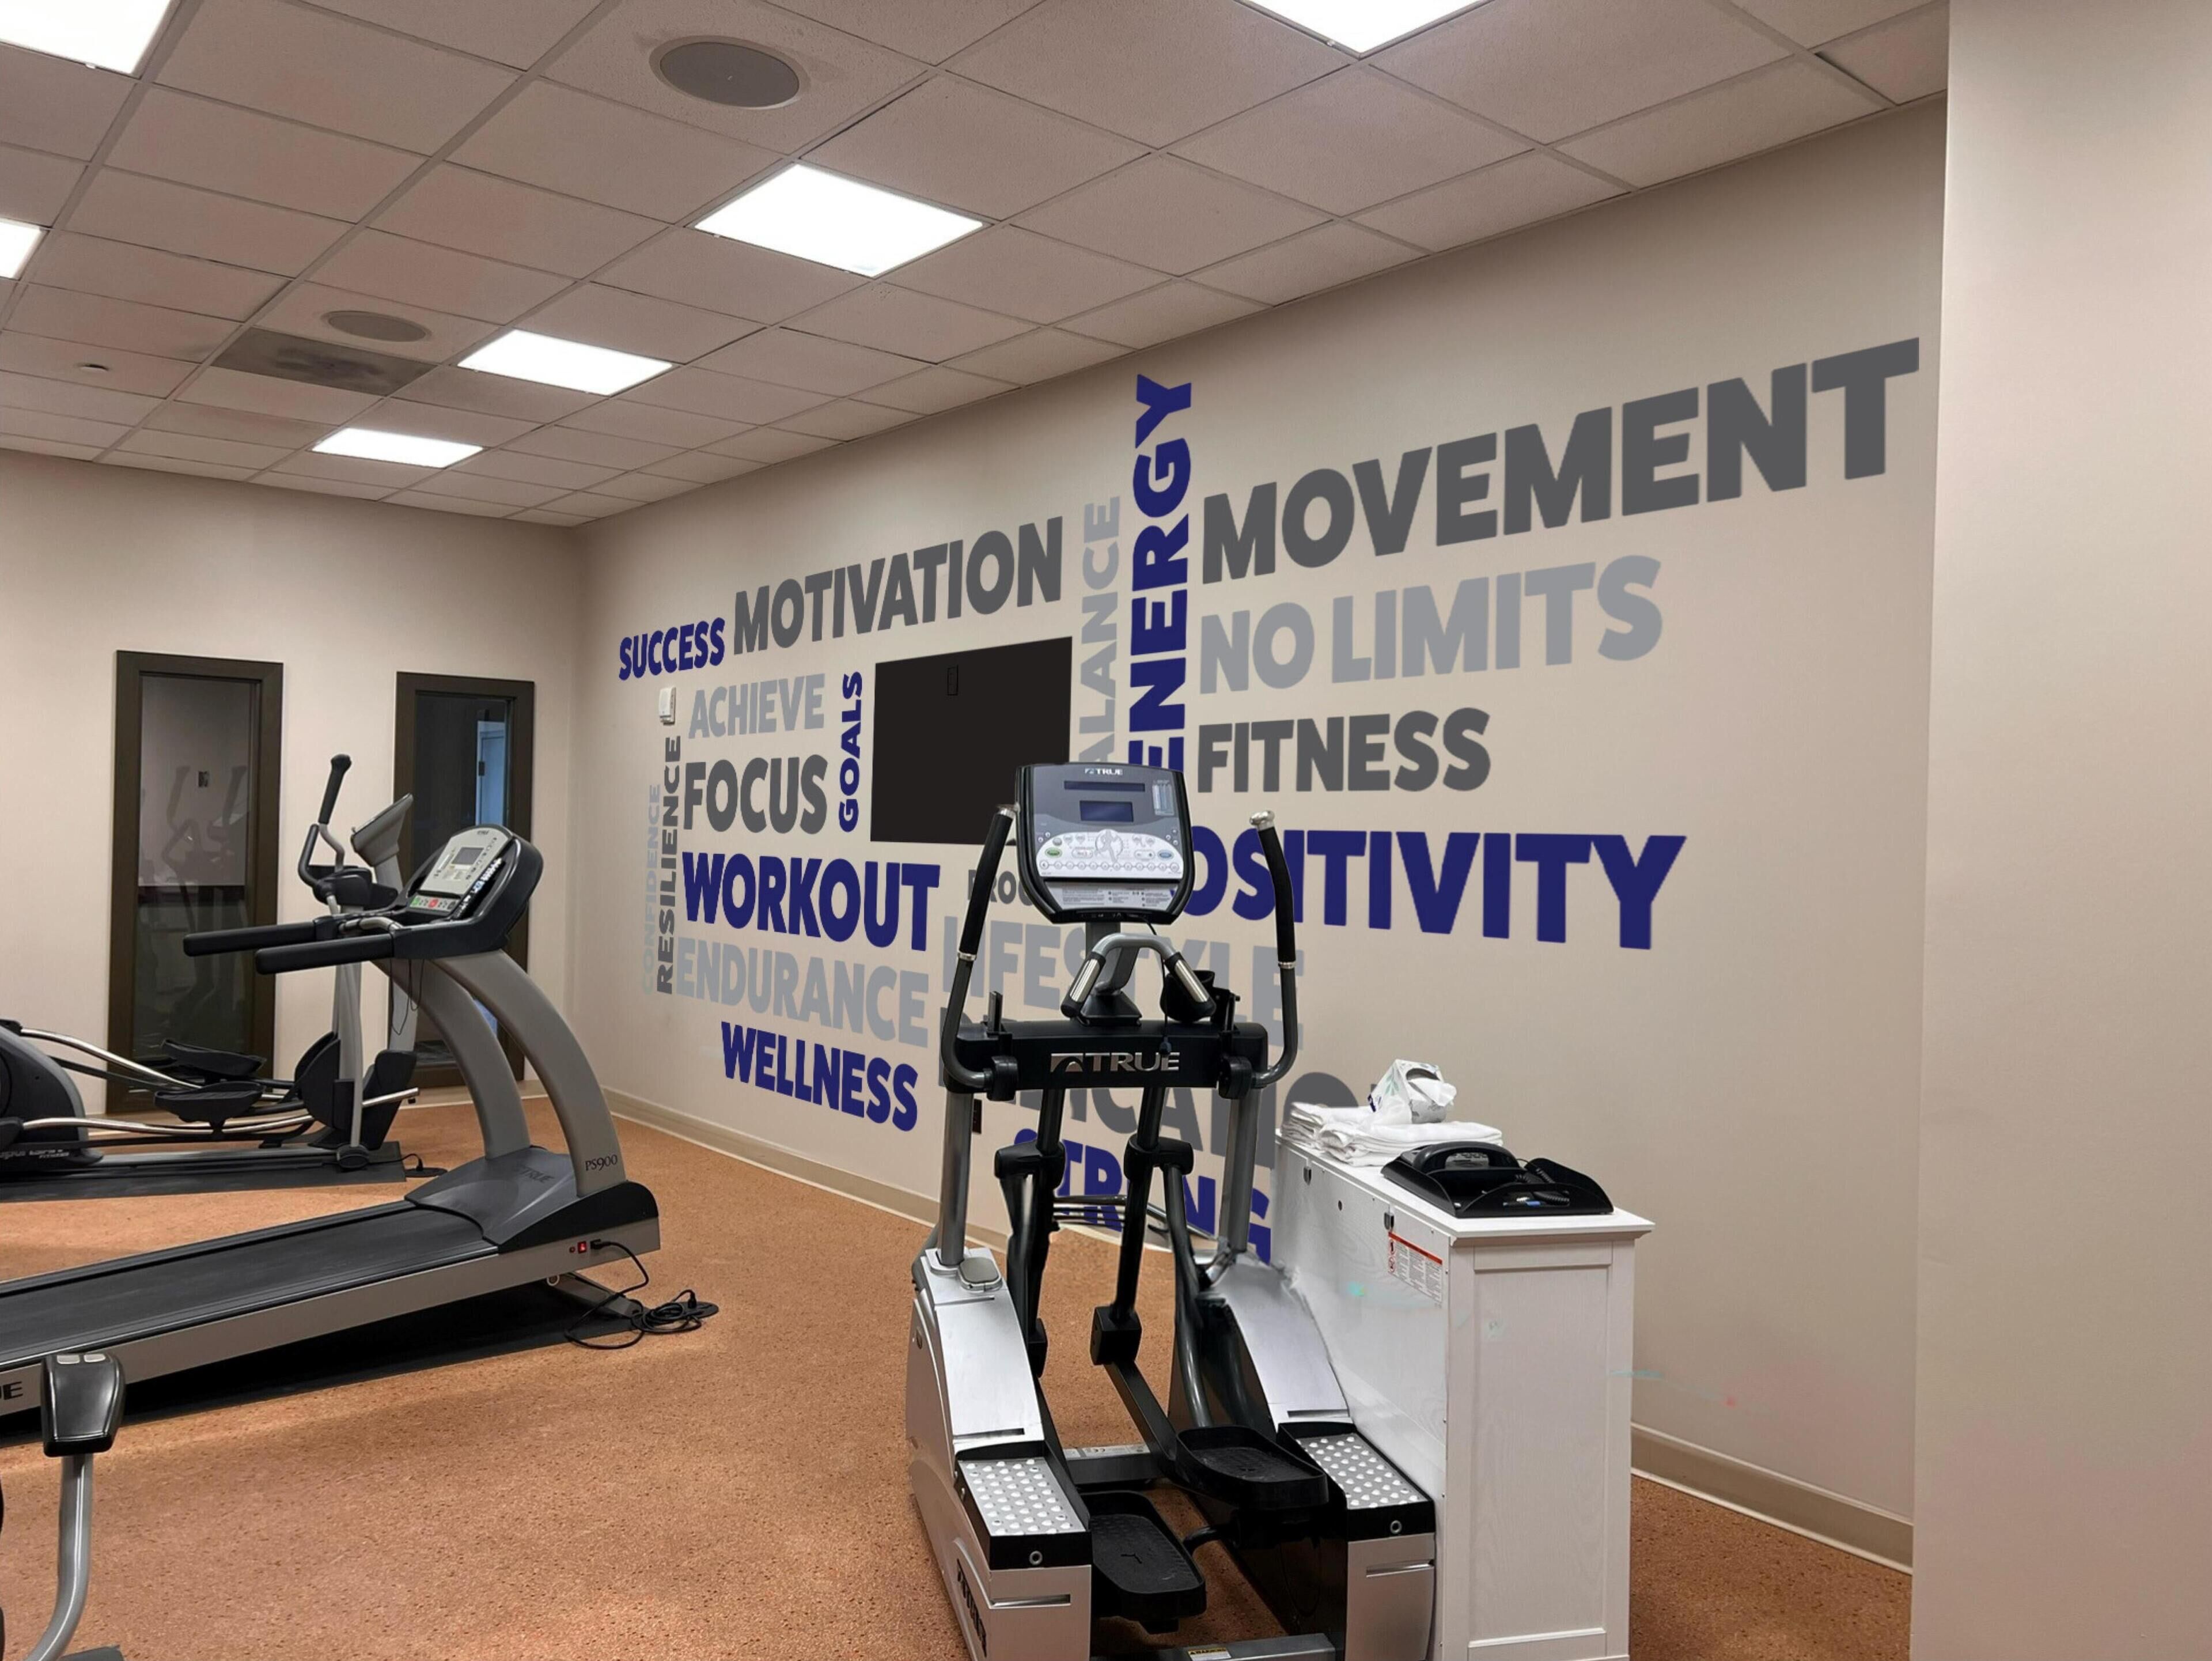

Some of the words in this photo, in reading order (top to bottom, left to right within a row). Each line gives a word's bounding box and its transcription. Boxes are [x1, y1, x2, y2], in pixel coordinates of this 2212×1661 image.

[1202, 337, 1919, 584] MOVEMENT
[733, 516, 1063, 655] MOTIVATION
[1078, 495, 1120, 763] LANCE
[1200, 602, 1315, 694] NO
[1332, 555, 1662, 683] LIMITS
[619, 617, 725, 680] SUCCESS
[688, 673, 825, 739] ACHIEVE
[839, 671, 863, 833] GOALS
[1198, 707, 1491, 793] FITNESS
[683, 754, 828, 834] FOCUS
[1097, 768, 1123, 776] TRUE
[642, 784, 661, 996] CONFIDENCE
[657, 735, 681, 994] RESILIENCE
[682, 852, 940, 951] WORKOUT
[1183, 826, 1687, 950] OSITIVITY
[676, 937, 929, 1048] ENDURANCE
[721, 1021, 919, 1132] WELLNESS
[1085, 1052, 1180, 1072] TRUE
[585, 1154, 618, 1171] PS900
